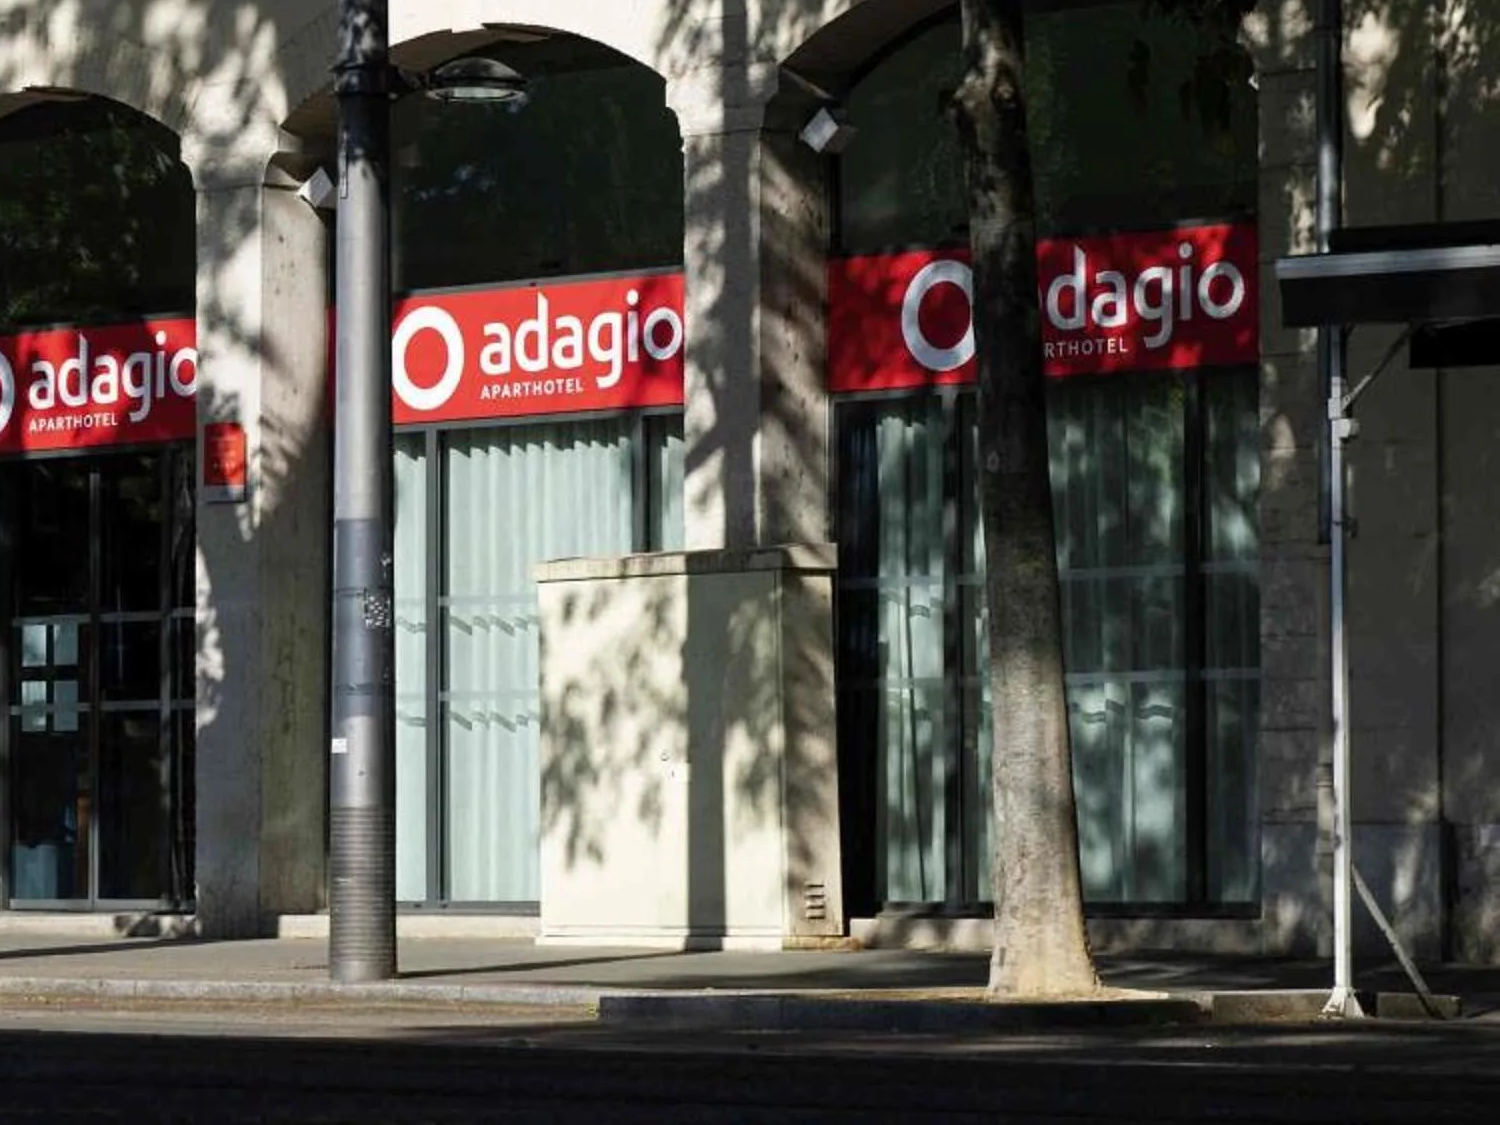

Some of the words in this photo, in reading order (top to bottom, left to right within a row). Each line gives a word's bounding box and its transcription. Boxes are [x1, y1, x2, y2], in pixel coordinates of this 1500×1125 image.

[1038, 242, 1246, 349] dagio
[479, 288, 684, 389] adagio
[1044, 337, 1129, 359] RTHOTEL
[28, 330, 198, 423] adagio
[479, 377, 585, 400] APARTHOTEL
[28, 411, 119, 433] APARTHOTEL
